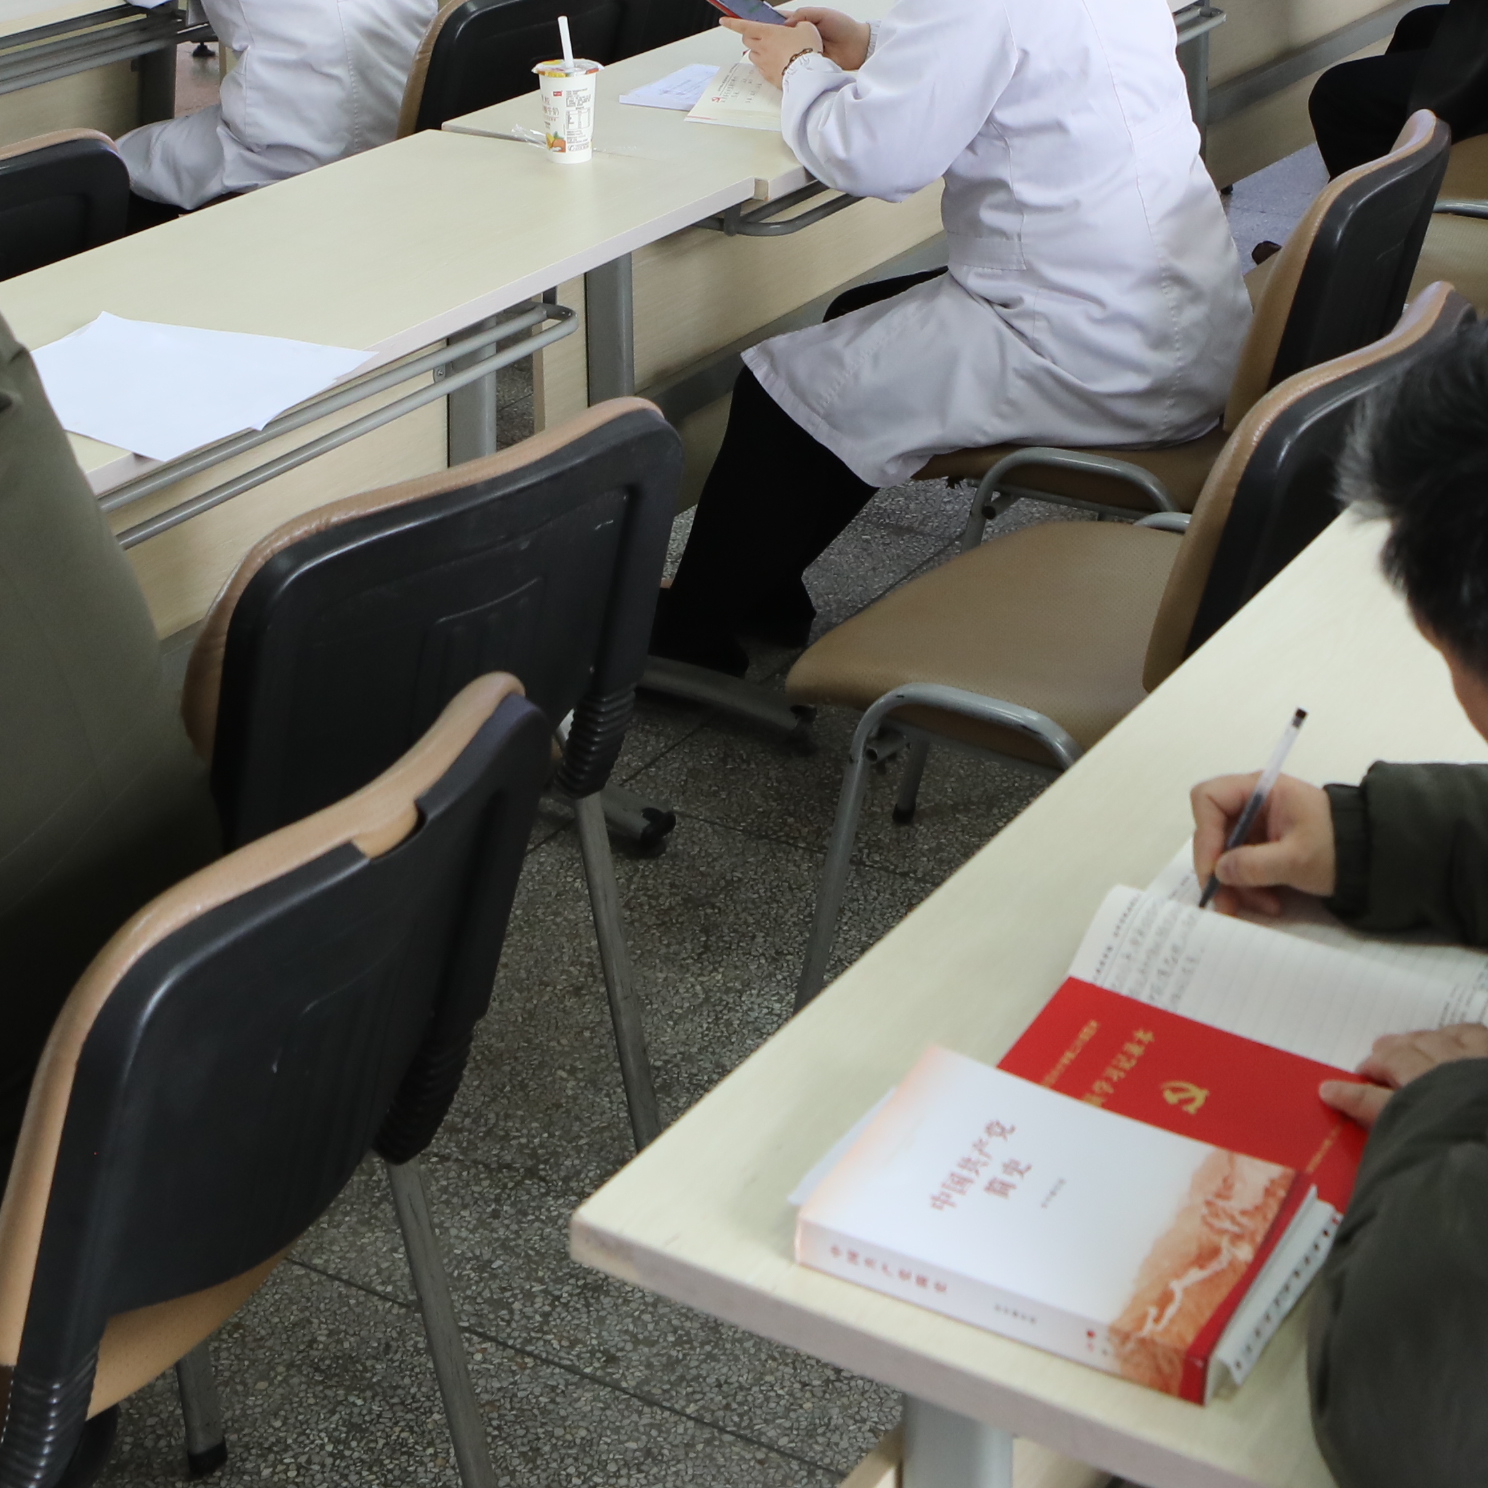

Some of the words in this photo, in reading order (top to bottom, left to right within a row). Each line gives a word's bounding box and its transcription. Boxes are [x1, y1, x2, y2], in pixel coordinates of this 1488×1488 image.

[930, 1120, 1016, 1211] 中国共产党
[983, 1158, 1033, 1200] 简史
